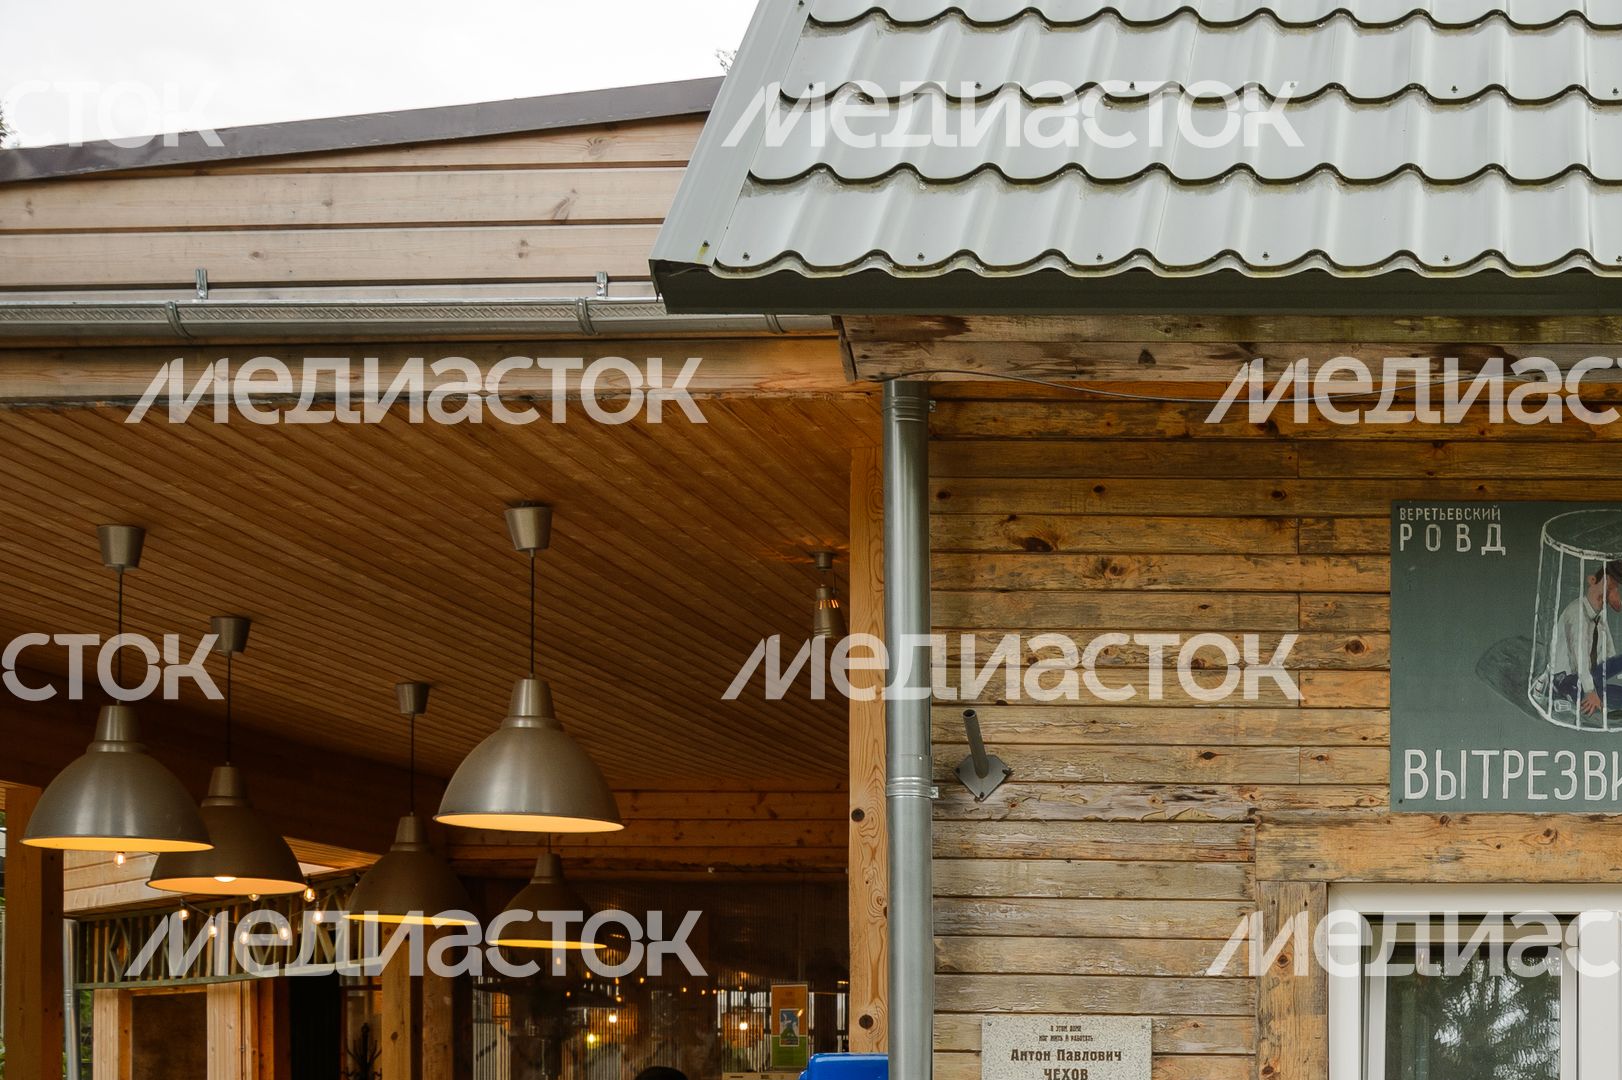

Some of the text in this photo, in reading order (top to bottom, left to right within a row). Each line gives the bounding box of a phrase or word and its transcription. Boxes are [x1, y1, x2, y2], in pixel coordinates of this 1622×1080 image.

[1399, 506, 1501, 521] ВЕРЕТЬЕВСКИЙ
[1010, 1049, 1122, 1061] Антон Павлович
[1043, 1068, 1088, 1080] ЧЕХОВ
